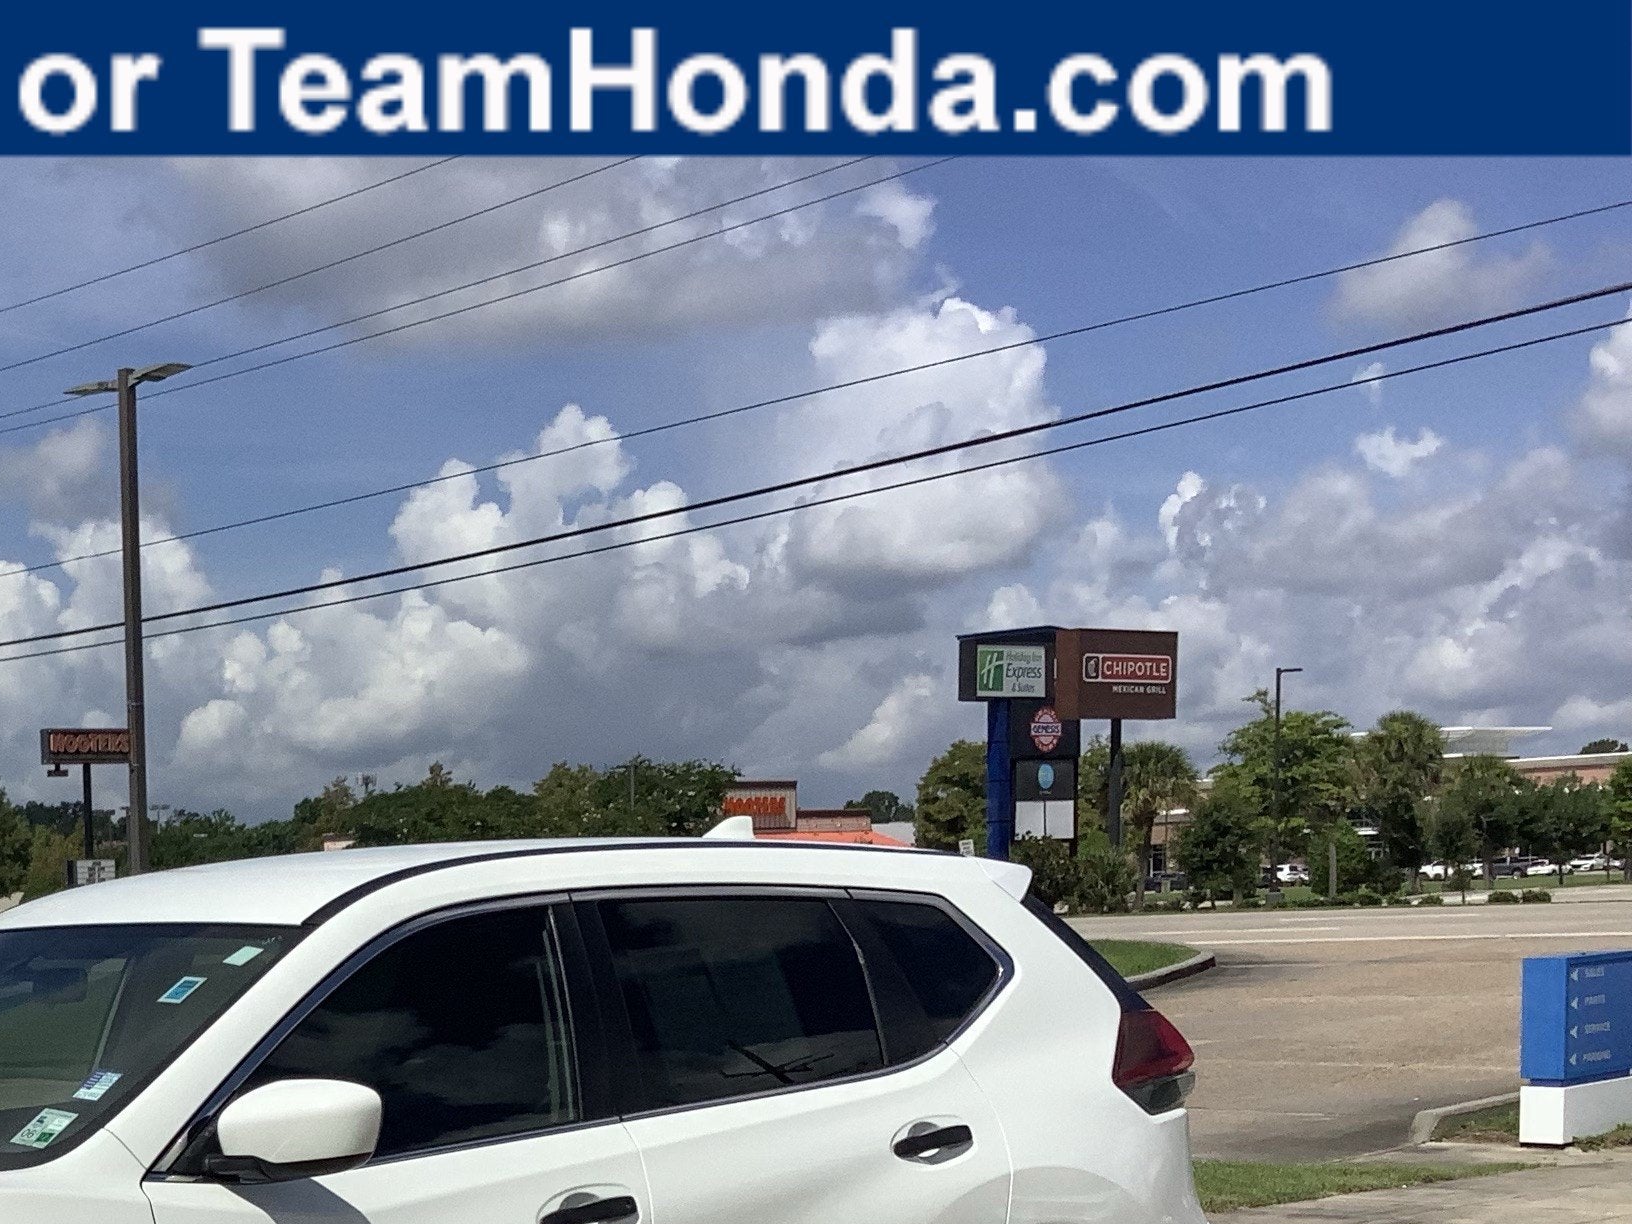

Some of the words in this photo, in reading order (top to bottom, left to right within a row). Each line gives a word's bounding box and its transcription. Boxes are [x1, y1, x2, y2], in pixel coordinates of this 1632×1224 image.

[1005, 662, 1042, 682] Express
[1103, 660, 1168, 677] CHIPOTLE
[1112, 685, 1144, 694] MEXICAN
[1146, 686, 1167, 695] GRILL
